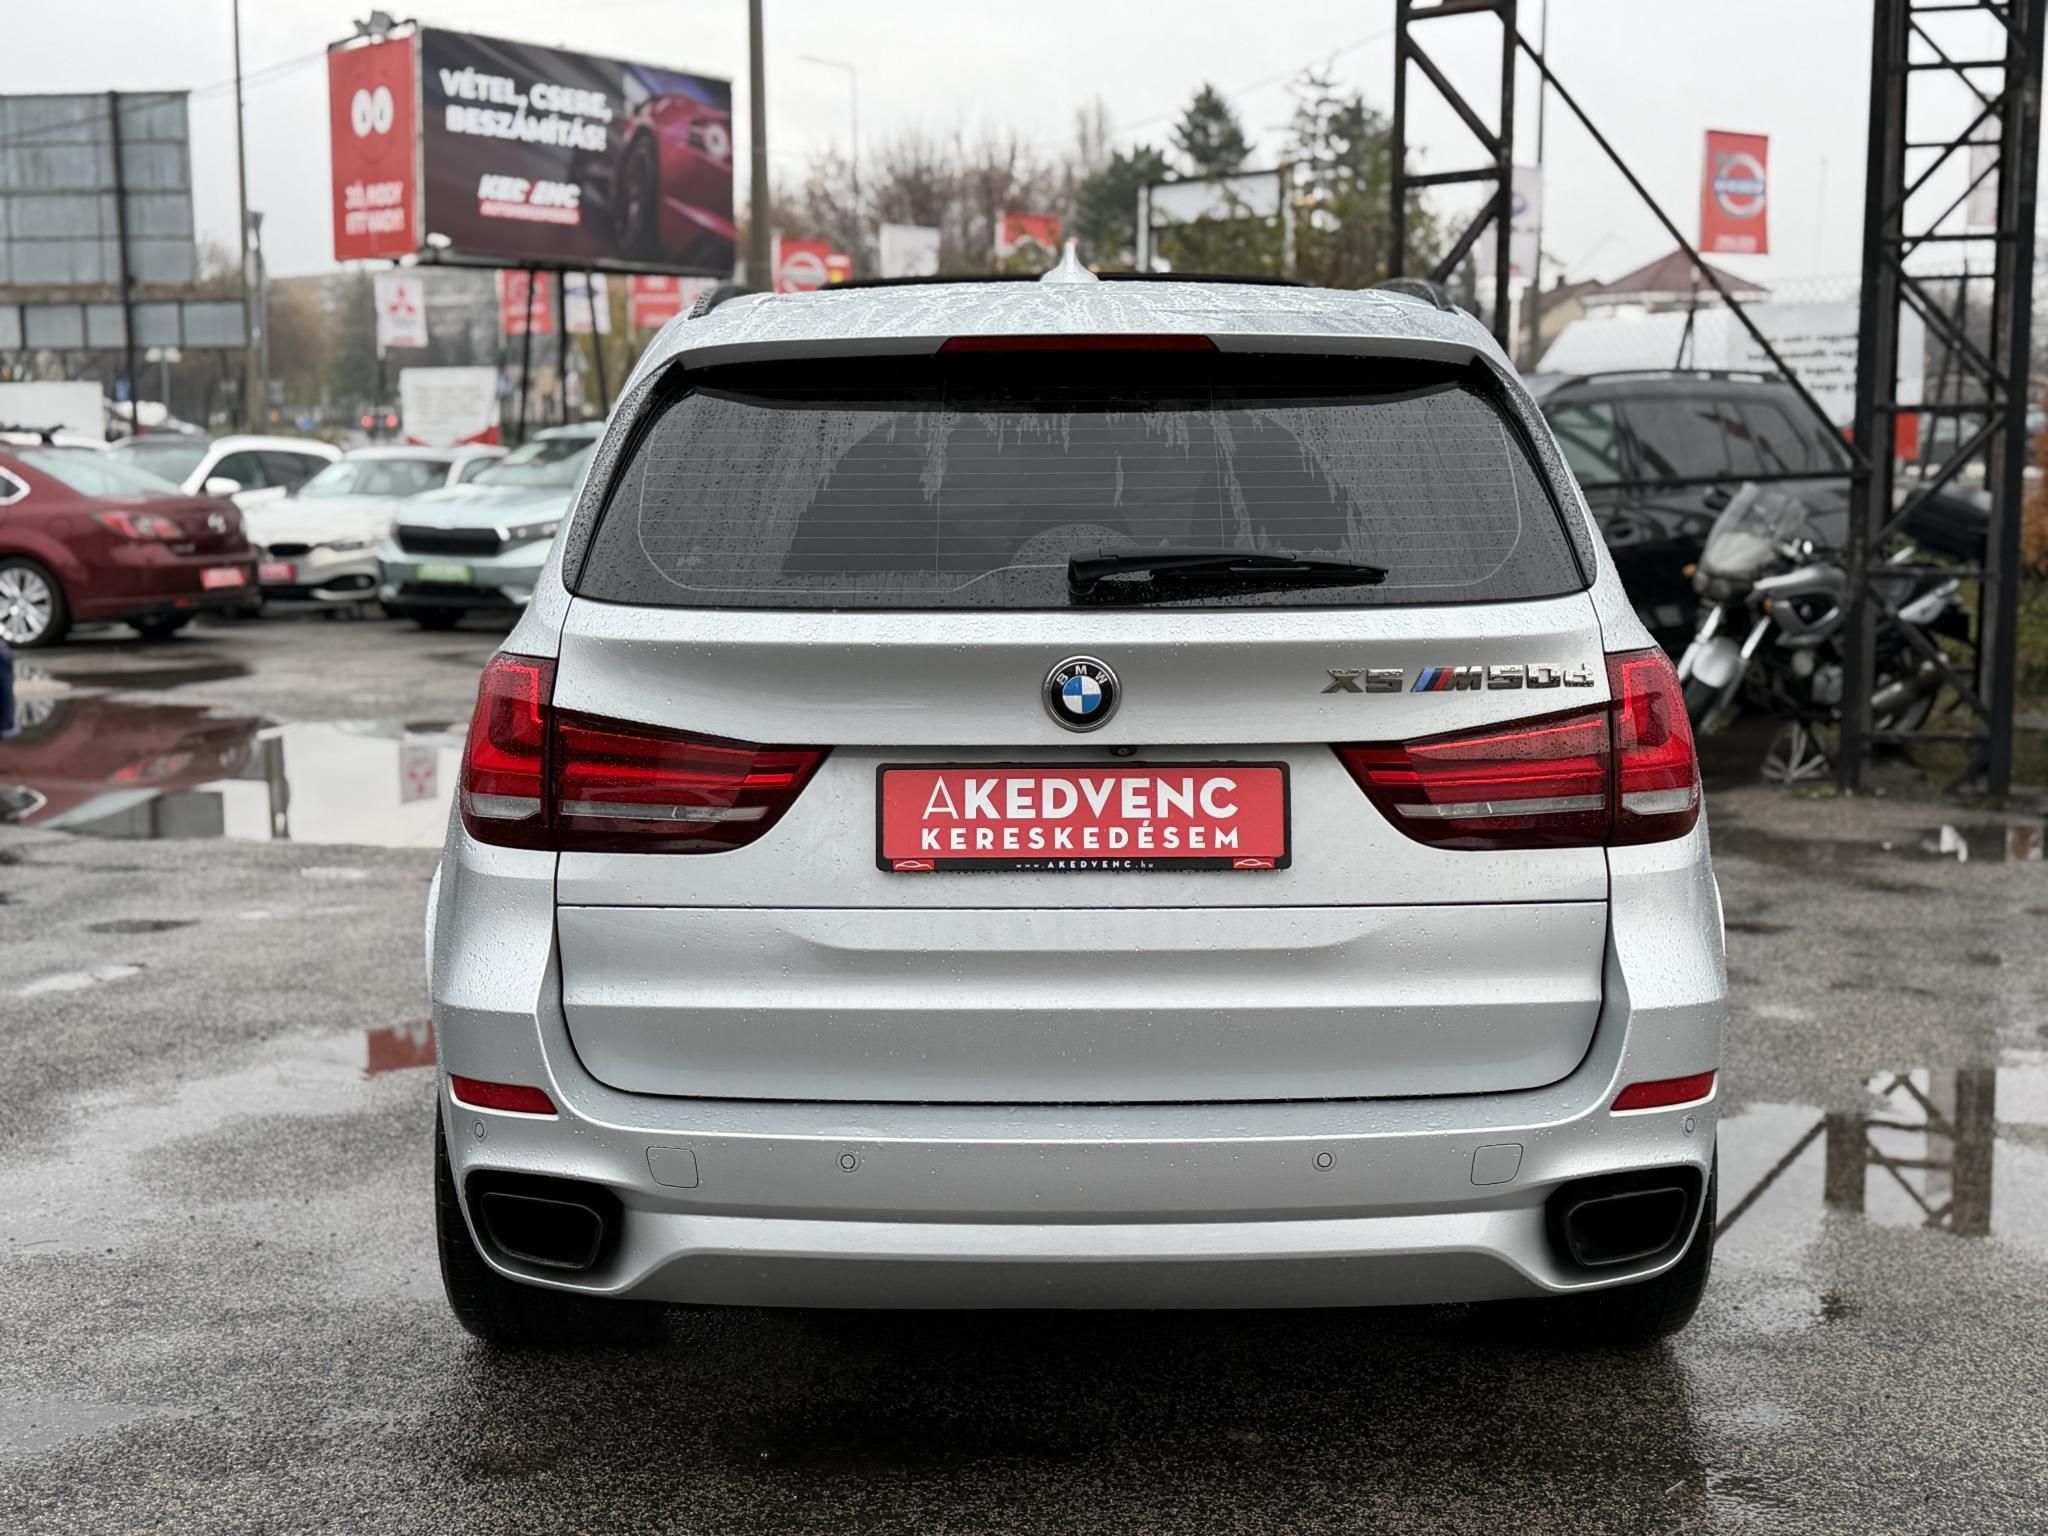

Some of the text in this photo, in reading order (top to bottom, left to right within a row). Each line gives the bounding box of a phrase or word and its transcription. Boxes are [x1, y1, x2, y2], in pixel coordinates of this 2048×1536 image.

[1056, 665, 1108, 686] BMW
[1321, 668, 1404, 694] X5
[921, 820, 1239, 851] KERESKEDÉSEM
